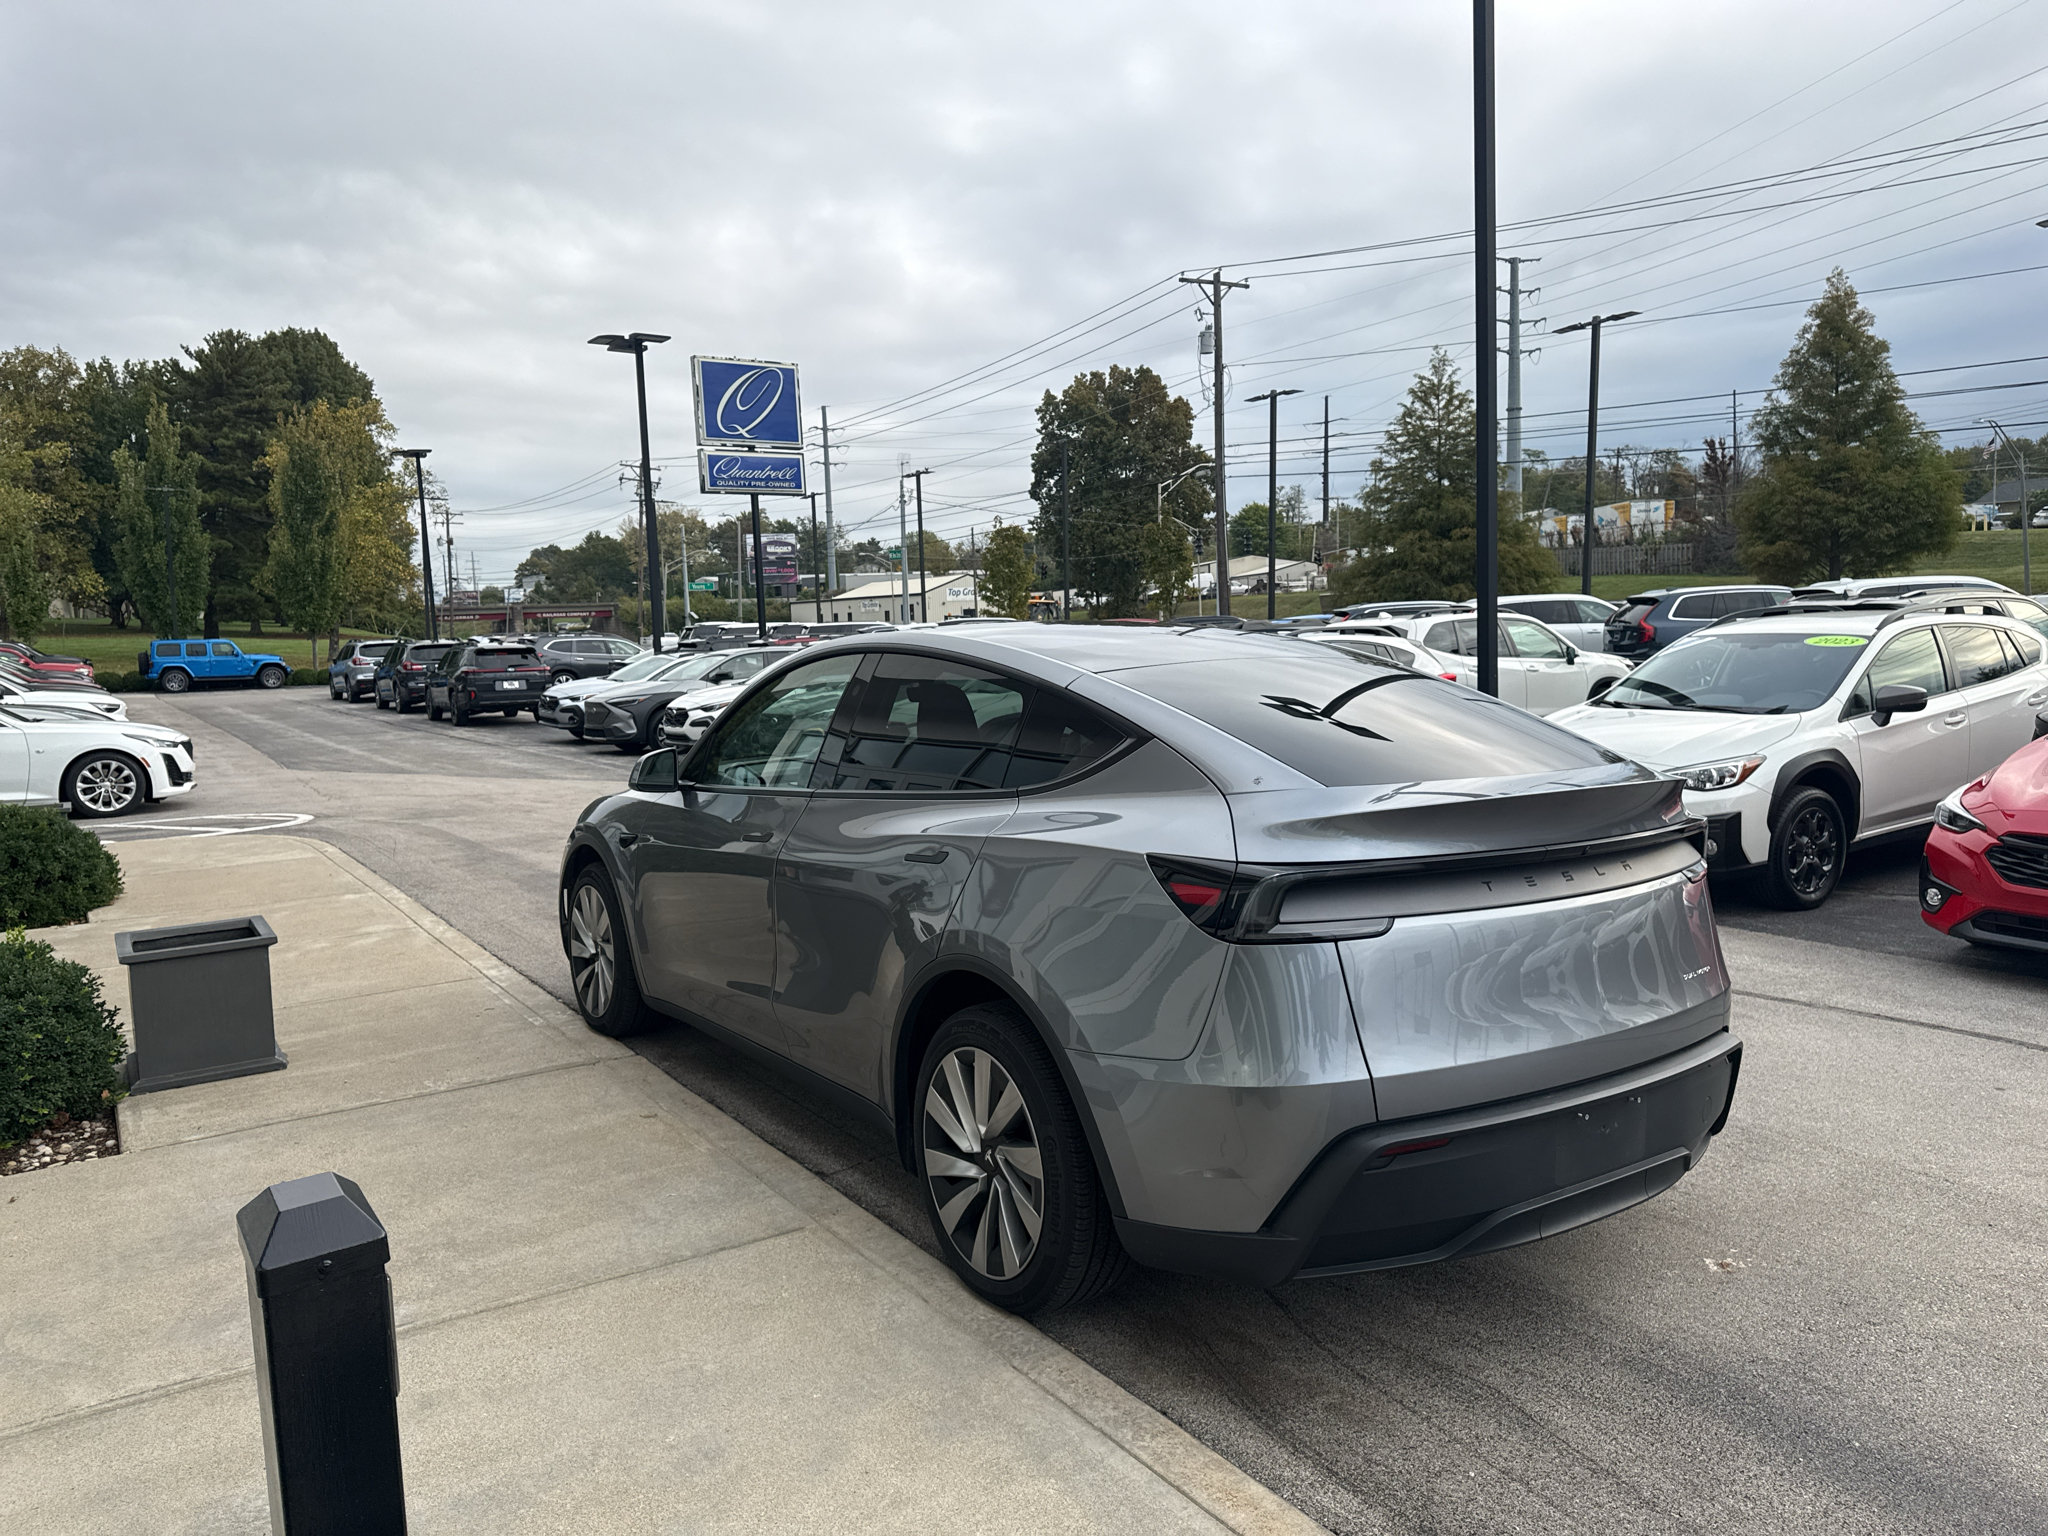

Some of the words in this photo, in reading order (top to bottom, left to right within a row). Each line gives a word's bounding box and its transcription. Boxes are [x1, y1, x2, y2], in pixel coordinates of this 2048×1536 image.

[716, 367, 784, 438] Q
[713, 456, 798, 480] Quantrell
[948, 588, 961, 598] Top
[1481, 860, 1633, 892] TESLA
